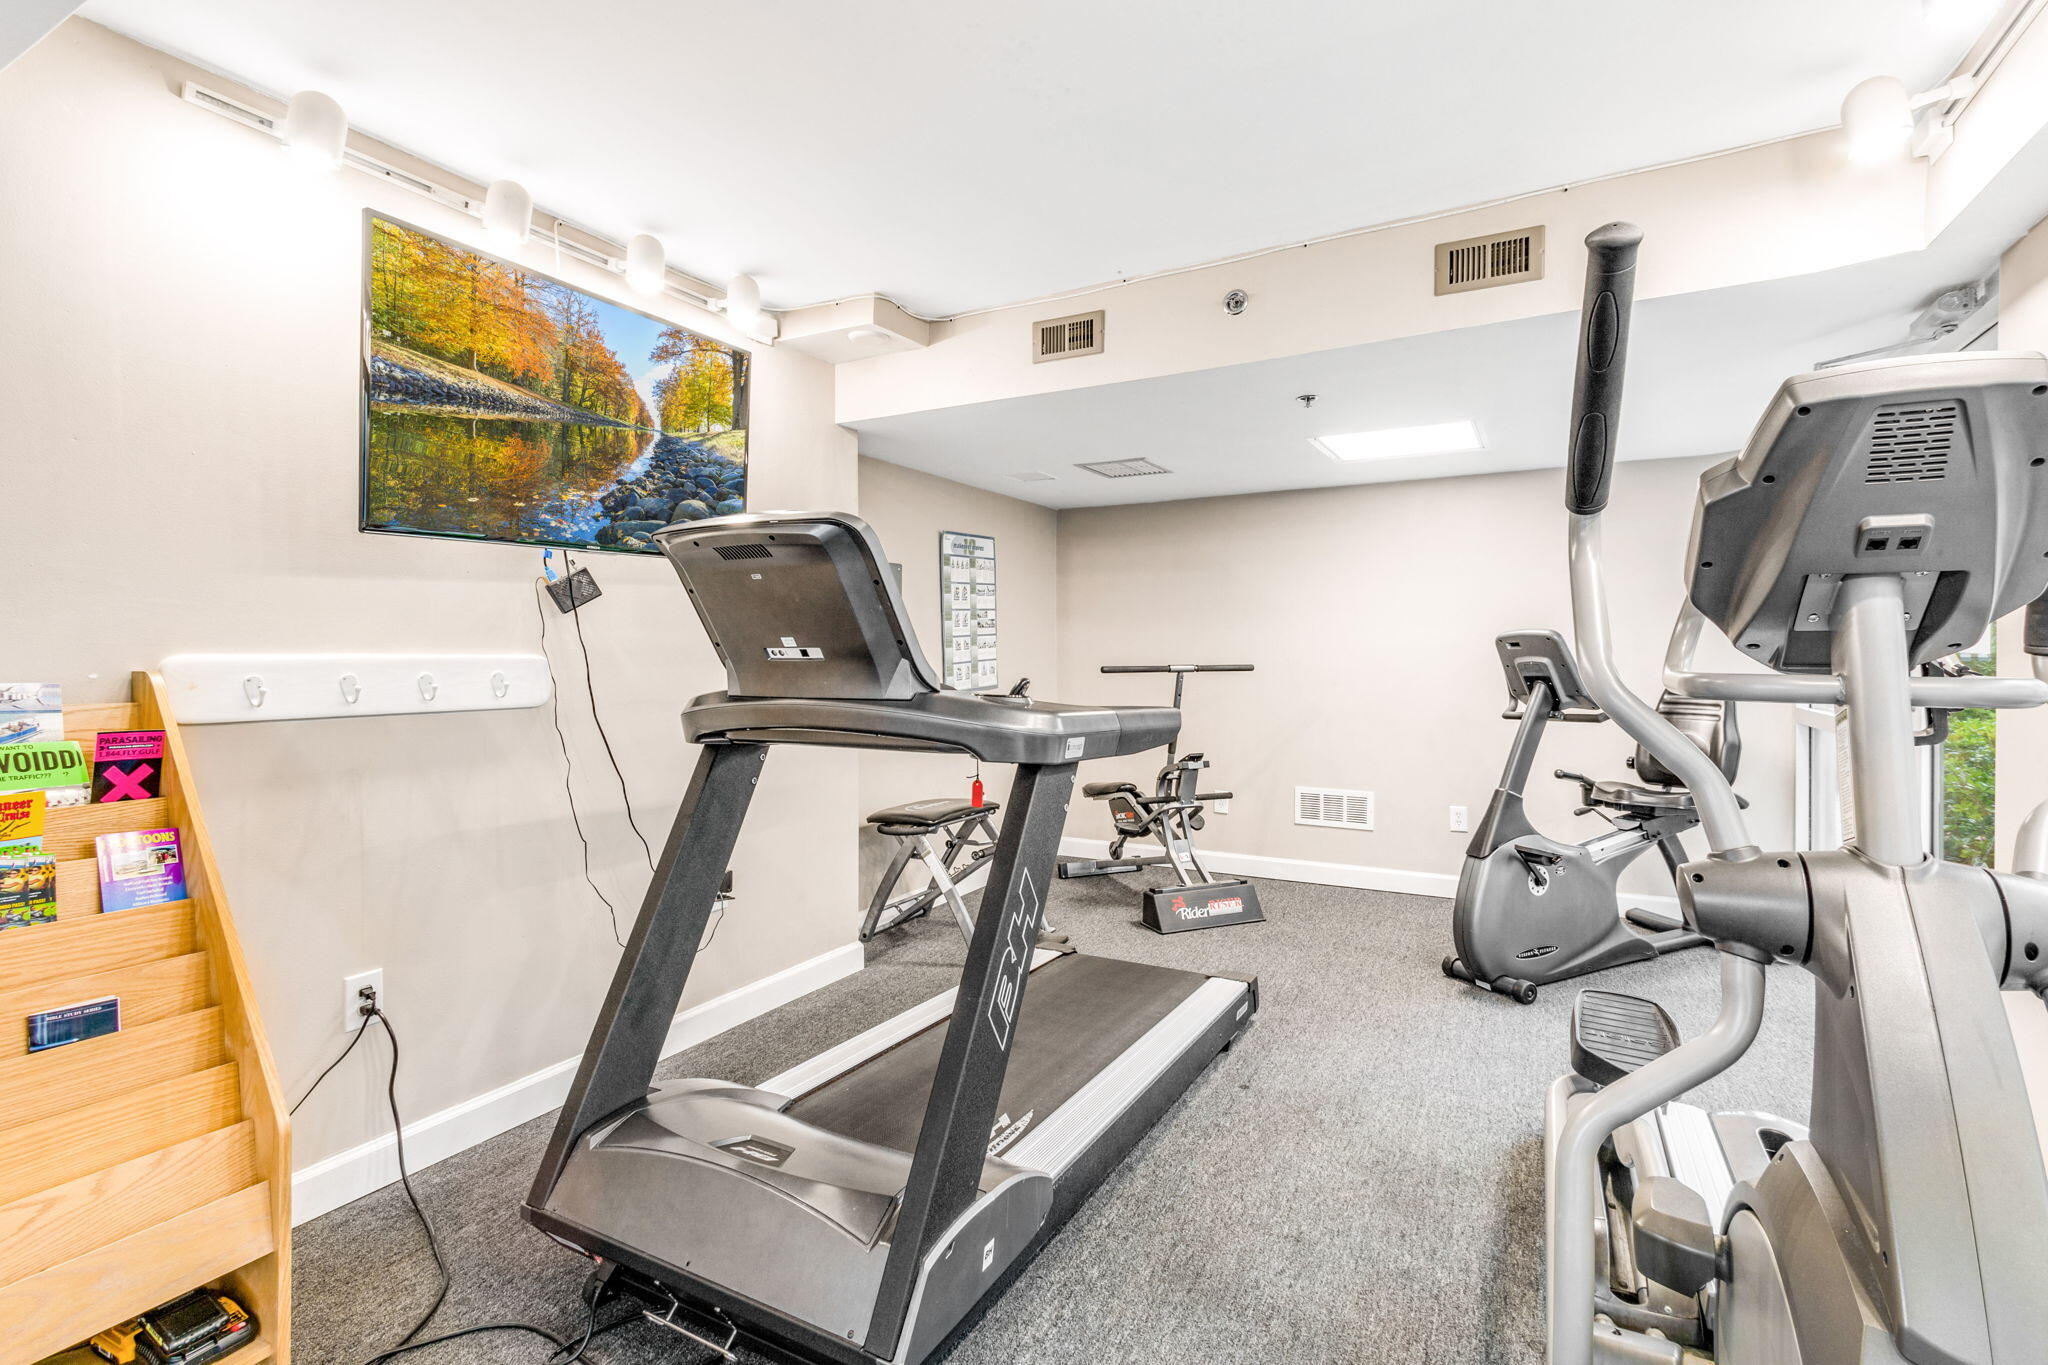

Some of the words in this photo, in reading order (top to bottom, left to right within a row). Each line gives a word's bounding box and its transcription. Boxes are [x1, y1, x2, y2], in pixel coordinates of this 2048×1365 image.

[99, 736, 163, 745] PARASAILING
[1175, 905, 1209, 920] Rider
[63, 1010, 82, 1018] STUDY
[83, 1005, 102, 1014] SERIES
